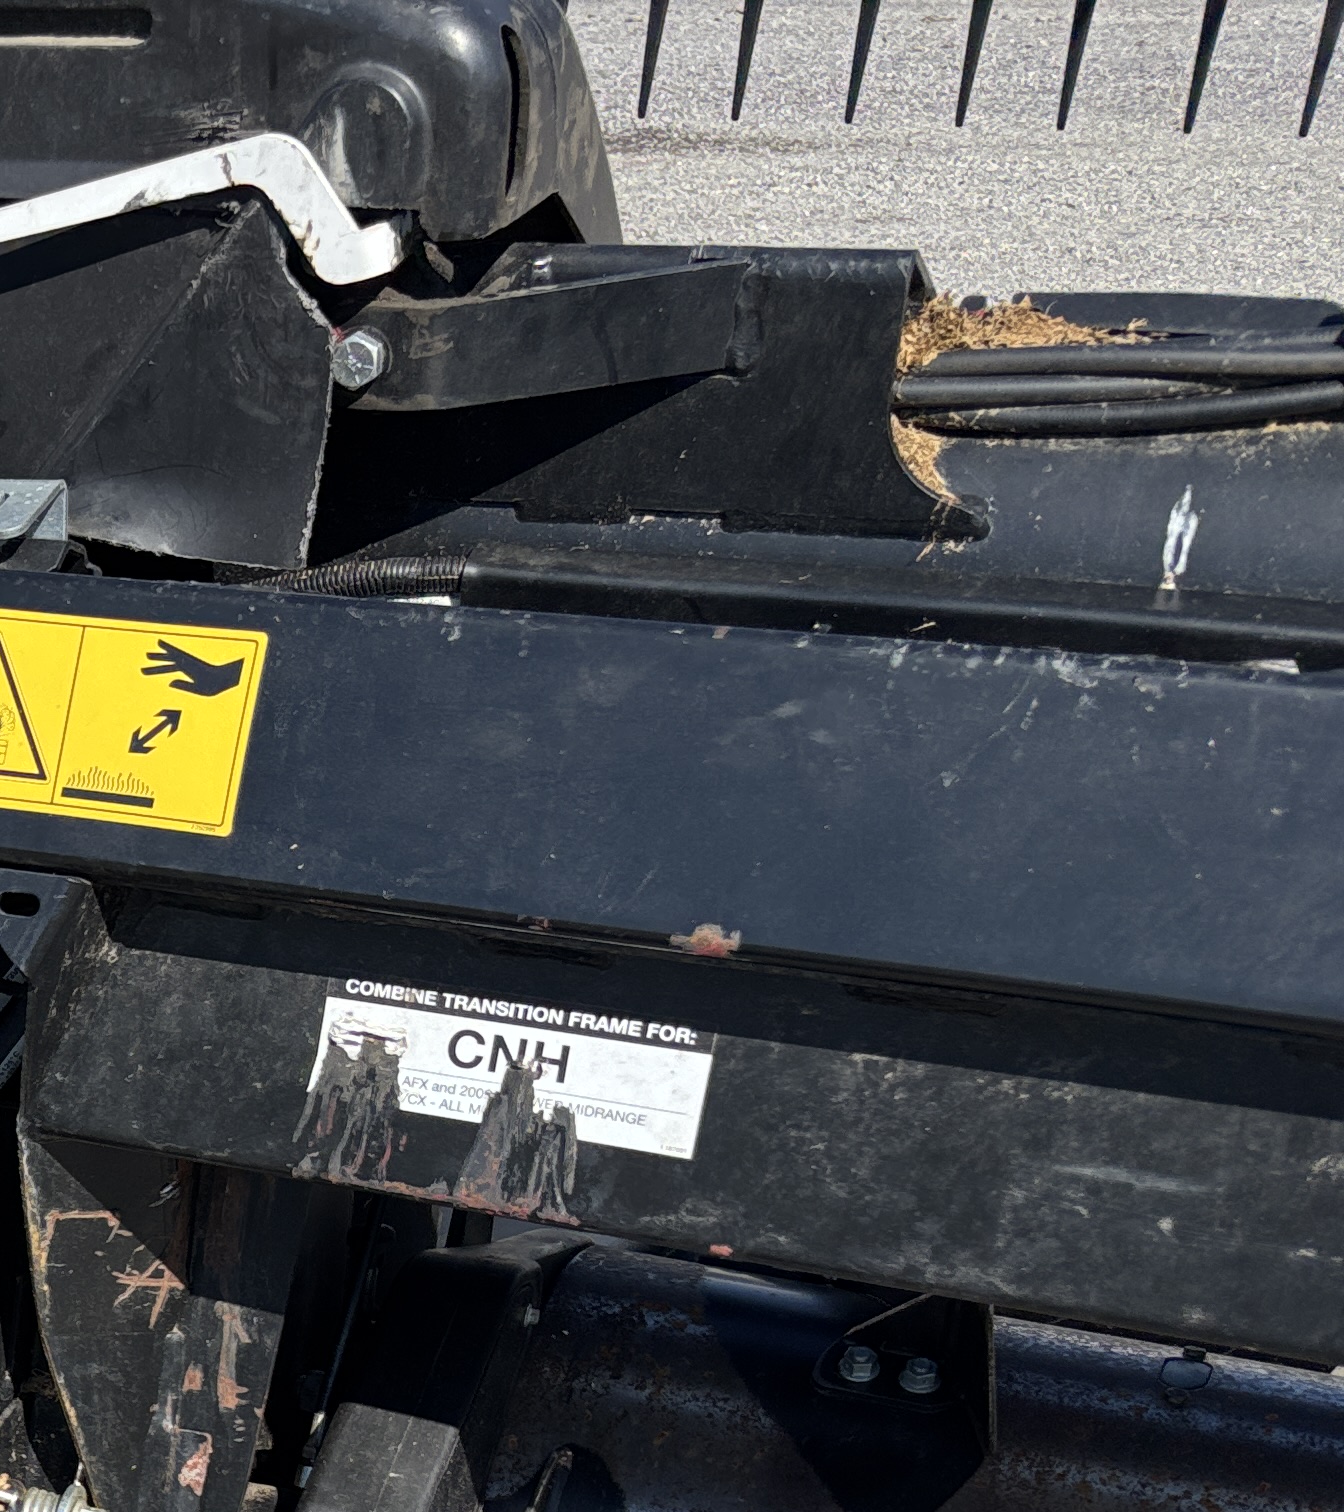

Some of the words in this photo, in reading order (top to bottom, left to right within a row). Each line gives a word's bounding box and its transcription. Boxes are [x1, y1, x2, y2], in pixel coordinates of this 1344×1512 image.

[345, 977, 437, 1007] COMBINE
[442, 992, 564, 1026] TRANSITION
[568, 1011, 643, 1038] FRAME
[645, 1023, 698, 1045] FOR:
[447, 1029, 571, 1084] CNH
[401, 1075, 430, 1091] AFX
[431, 1082, 457, 1095] and
[568, 1102, 648, 1127] MIDRANGE
[438, 1098, 465, 1114] ALL
